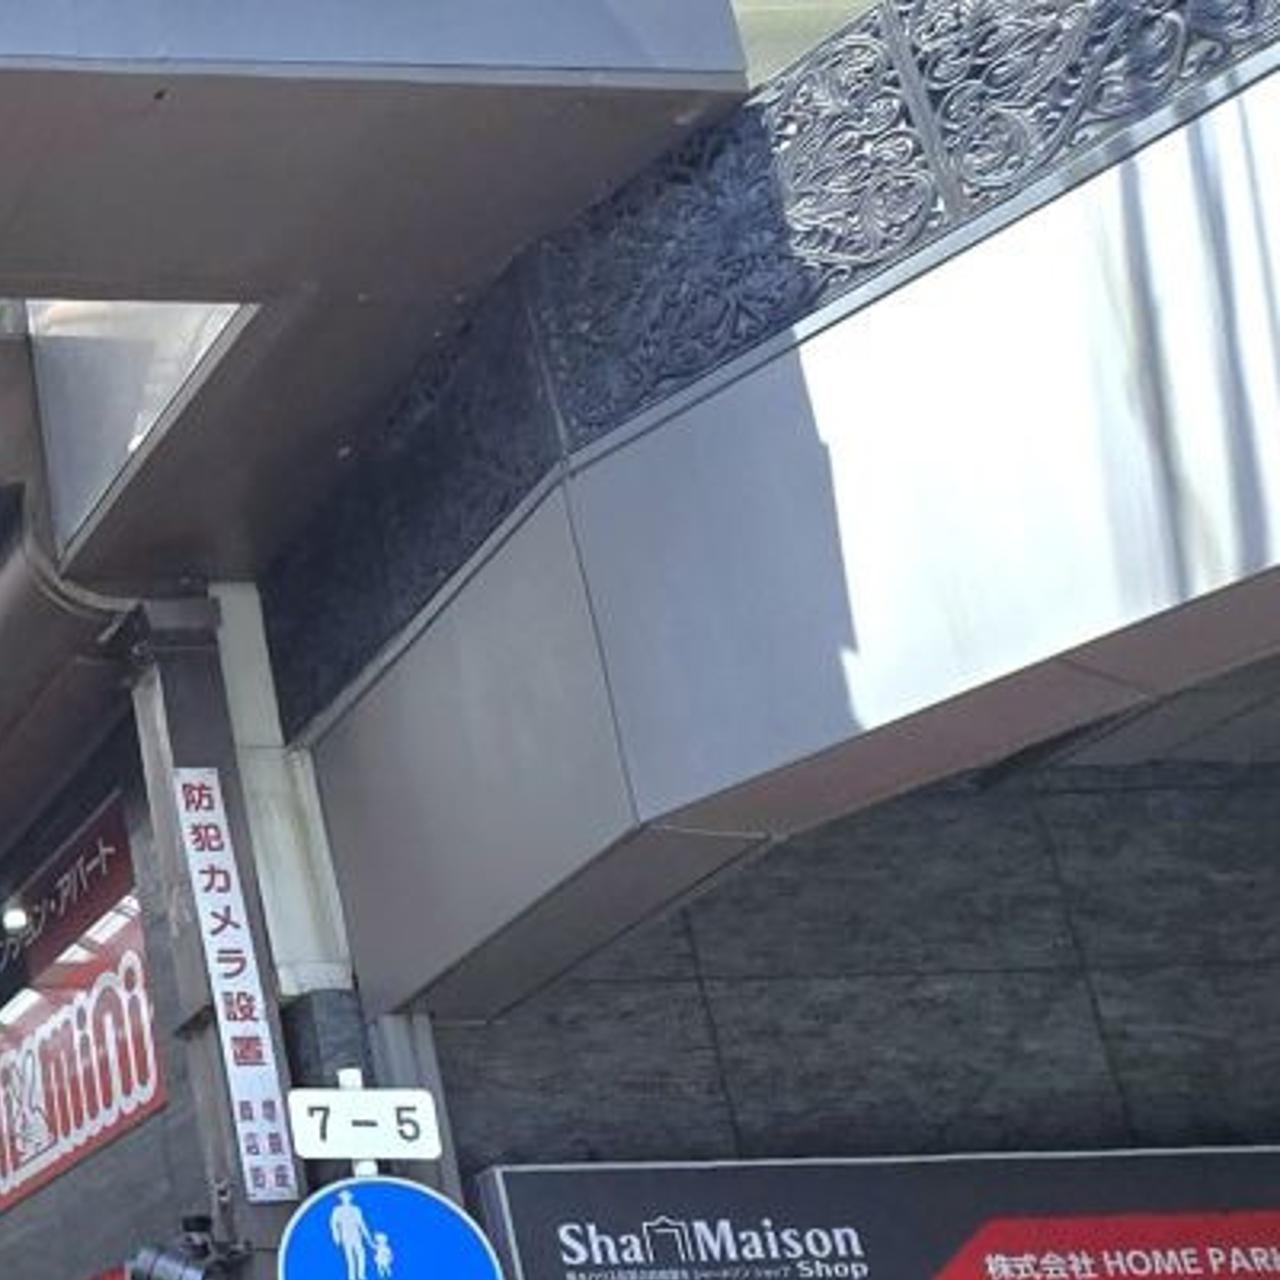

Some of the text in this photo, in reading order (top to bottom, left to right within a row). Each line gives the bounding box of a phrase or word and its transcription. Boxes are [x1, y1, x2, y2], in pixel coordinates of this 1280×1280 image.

[181, 782, 268, 1068] 防犯カメラ設置
[693, 1217, 864, 1263] Maison
[796, 1258, 869, 1280] Shop
[985, 1254, 1098, 1280] 株式会社
[1103, 1248, 1204, 1277] HOME
